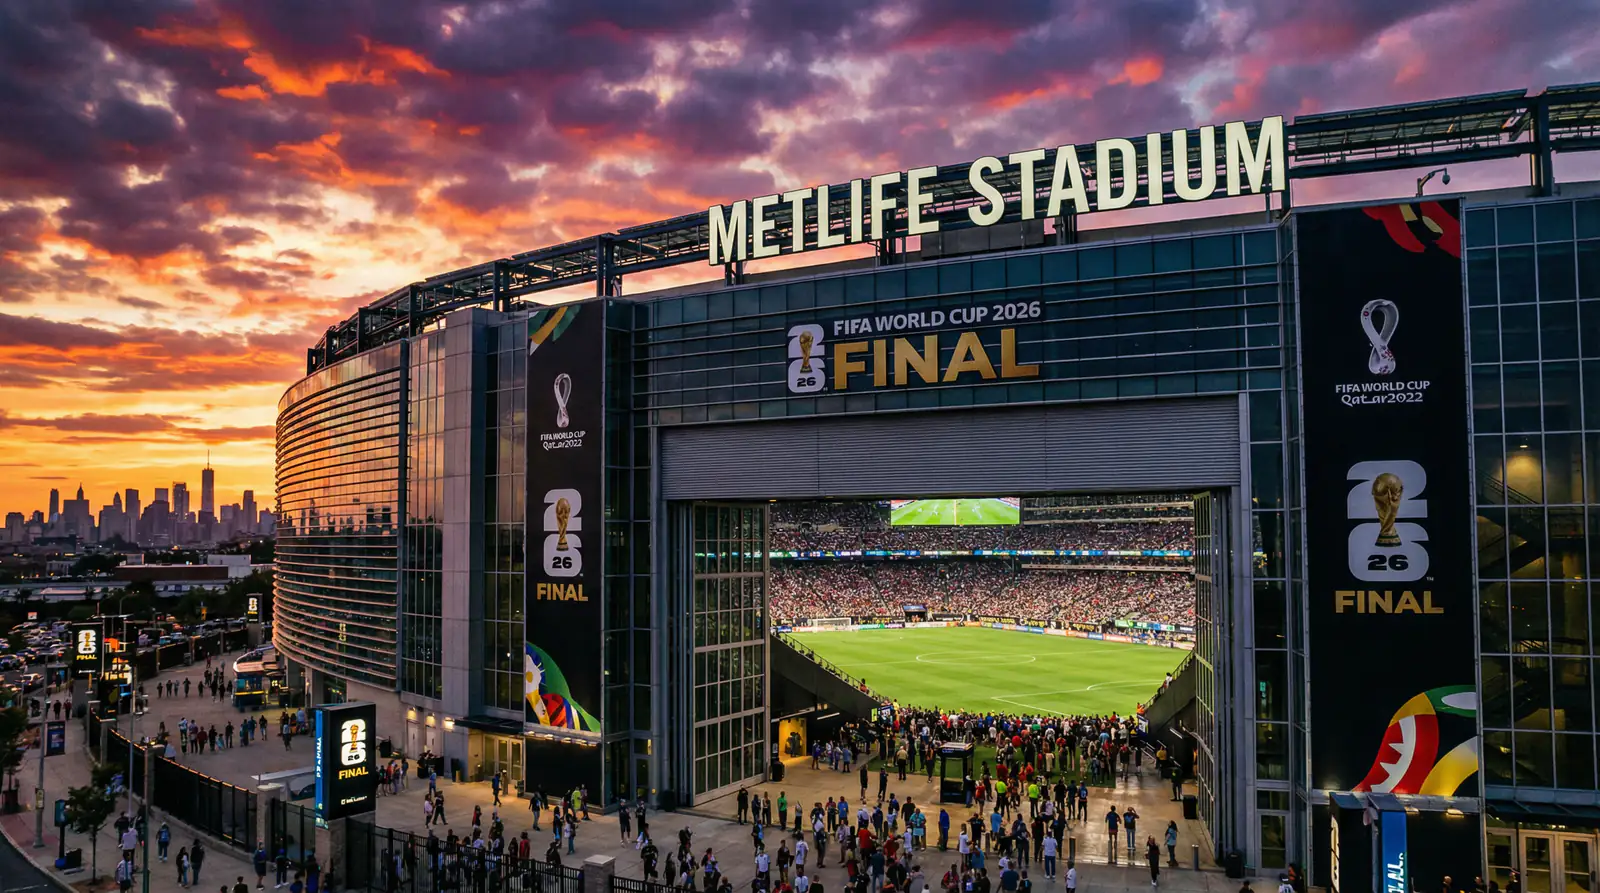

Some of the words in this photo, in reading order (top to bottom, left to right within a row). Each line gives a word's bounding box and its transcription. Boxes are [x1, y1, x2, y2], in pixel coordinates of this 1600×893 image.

[708, 166, 940, 266] METLIFE
[967, 115, 1287, 227] STADIUM
[833, 318, 873, 336] FIFA
[874, 309, 946, 332] WORLD
[948, 306, 989, 325] CUP
[992, 301, 1042, 322] 2026
[833, 328, 1040, 390] FINAL
[796, 376, 817, 388] 26
[1335, 383, 1361, 393] FIFA
[1361, 381, 1405, 392] WORLD
[1406, 380, 1431, 390] CUP
[540, 433, 553, 441] FIFA
[552, 431, 574, 441] WORLD
[574, 430, 586, 438] CUP
[551, 556, 573, 569] 26
[1367, 554, 1409, 571] 26
[536, 582, 589, 602] FINAL
[1335, 590, 1445, 614] FINAL
[338, 766, 369, 780] FINAL
